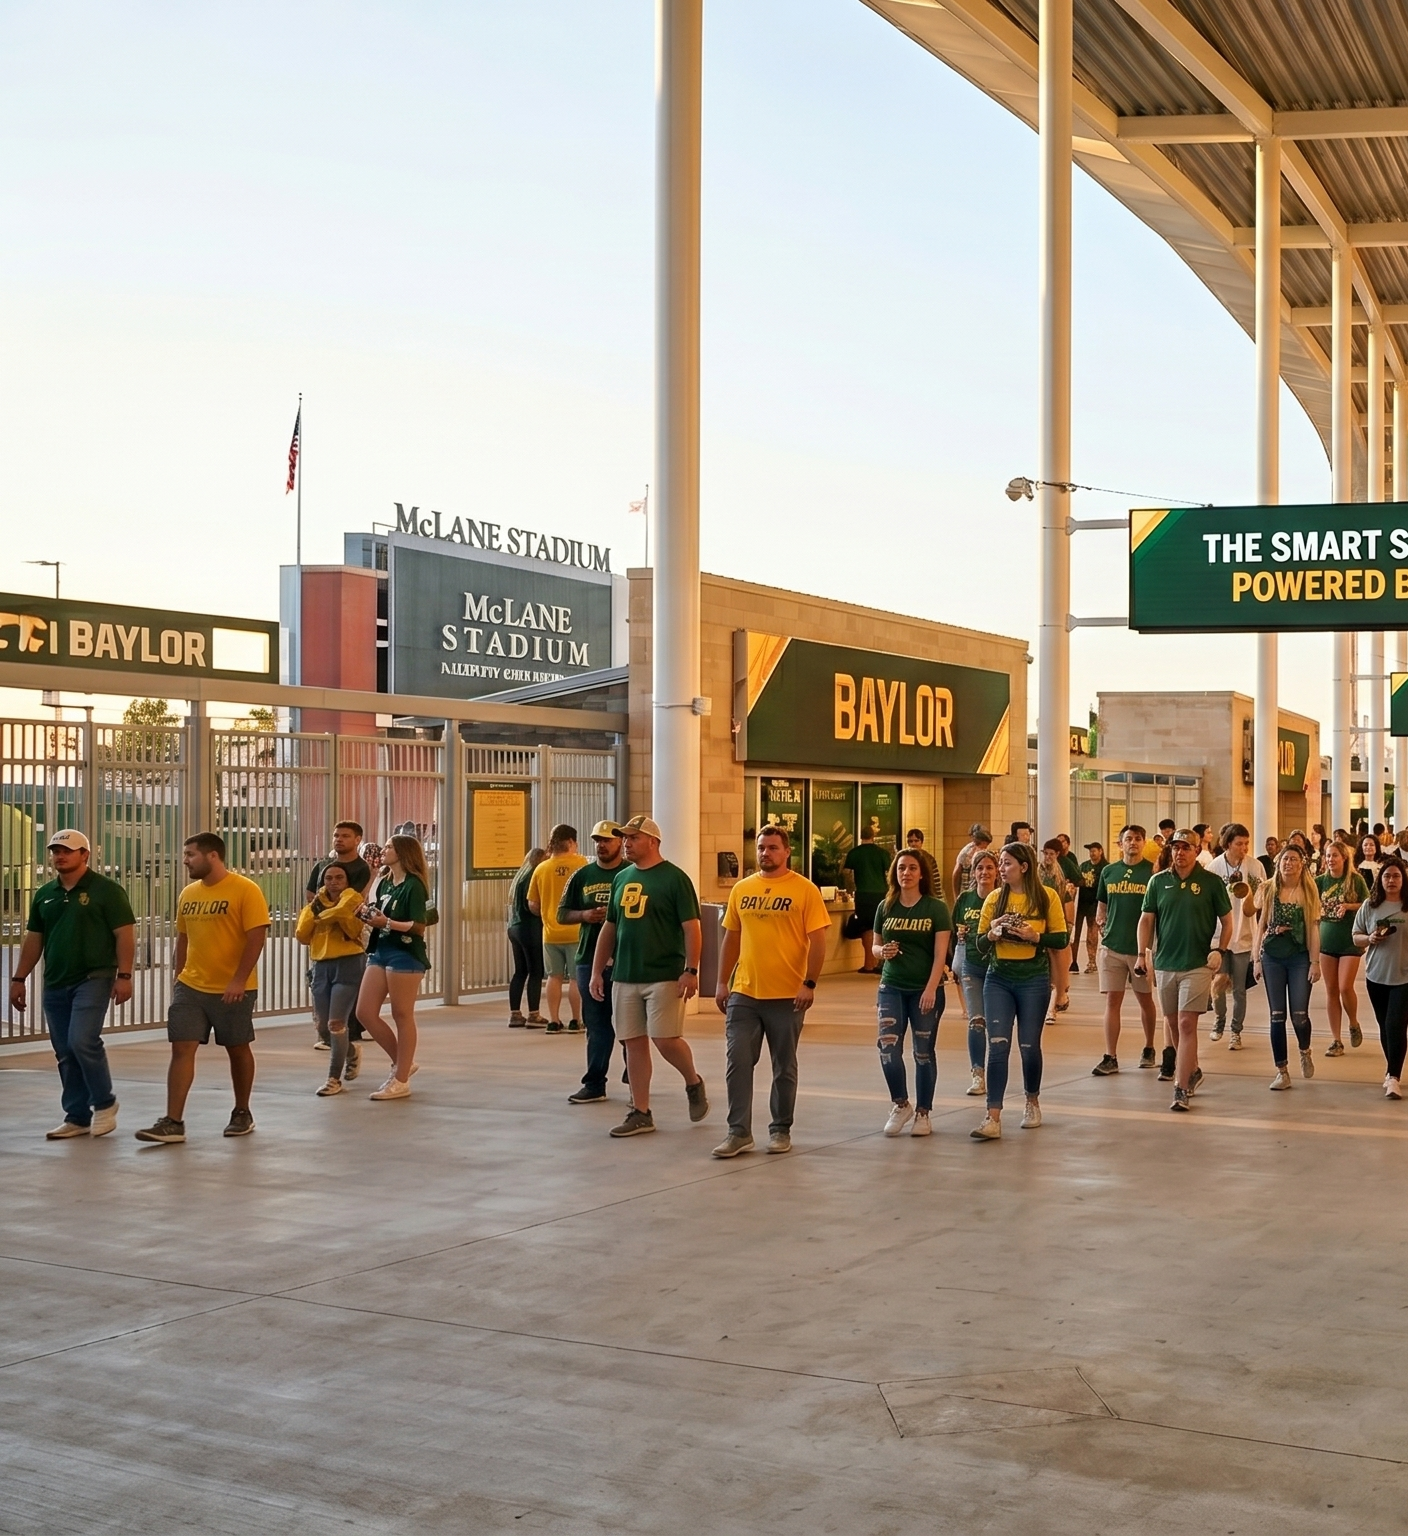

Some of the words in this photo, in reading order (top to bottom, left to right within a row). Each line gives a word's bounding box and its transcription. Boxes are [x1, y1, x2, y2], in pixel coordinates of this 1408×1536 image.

[393, 502, 503, 551] McLANE
[507, 527, 612, 573] STADIUM
[1203, 533, 1262, 564] THE
[1270, 529, 1383, 563] SMART
[1232, 569, 1386, 603] POWERED
[462, 591, 573, 634] McLANE
[69, 620, 207, 668] BAYLOR
[441, 624, 591, 667] STADIUM
[834, 672, 954, 748] BAYLOR
[181, 900, 229, 916] BAYLOR
[740, 895, 793, 911] BAYLOR
